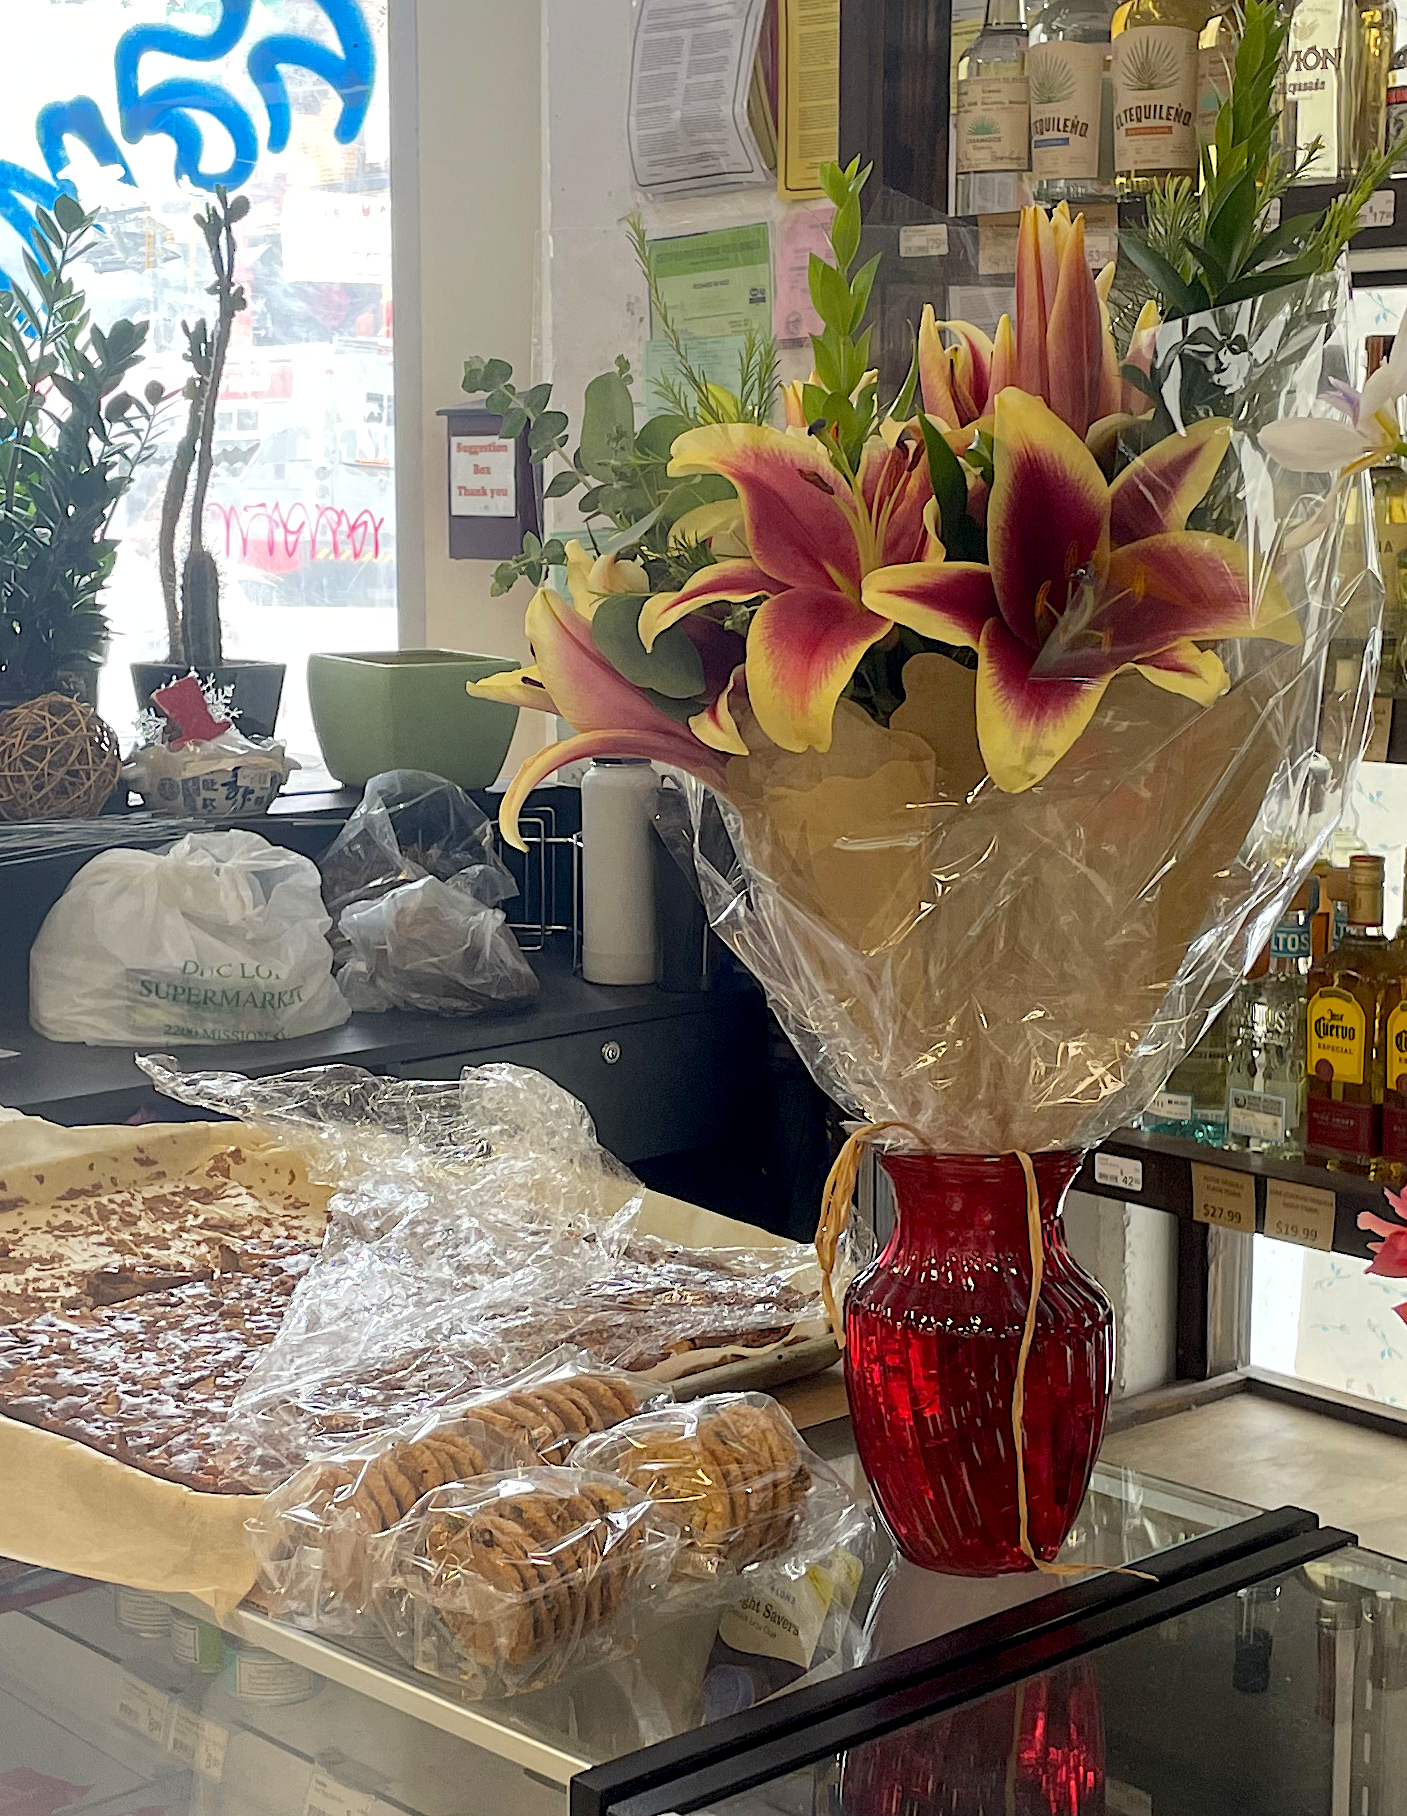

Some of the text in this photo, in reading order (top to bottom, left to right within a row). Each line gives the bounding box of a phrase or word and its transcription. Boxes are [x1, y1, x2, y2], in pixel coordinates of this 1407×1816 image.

[456, 442, 508, 456] Suggestion
[473, 463, 491, 475] Box
[457, 485, 508, 499] Thank you
[1314, 1016, 1355, 1041] Cuervo
[1318, 1043, 1354, 1055] ESPECIAL
[1203, 1203, 1242, 1224] $27.99
[1275, 1220, 1318, 1242] $19.99
[763, 1603, 799, 1637] Savers
